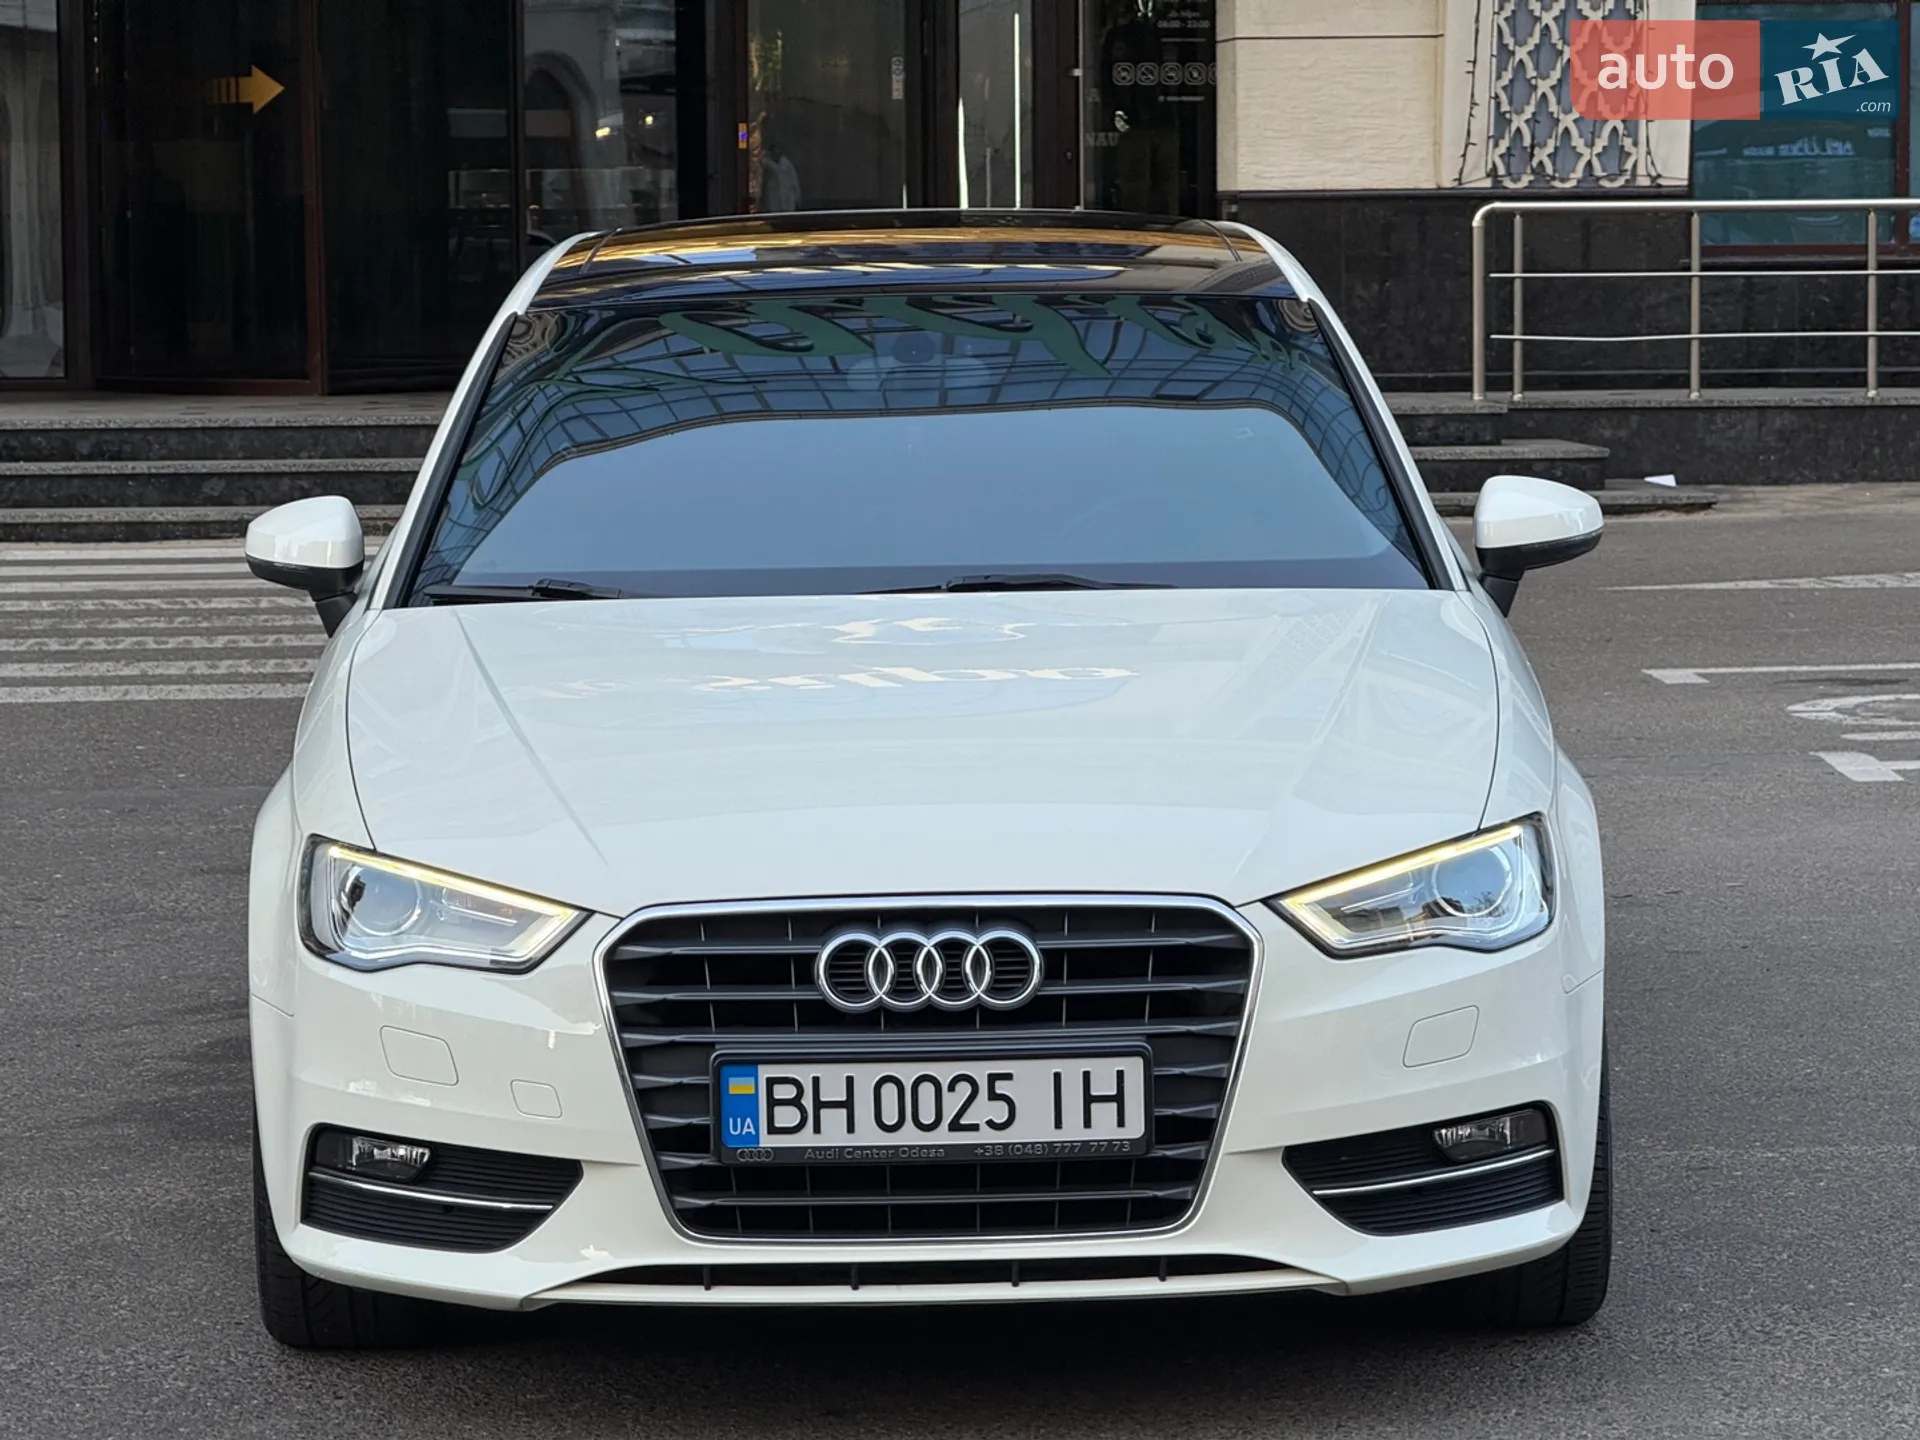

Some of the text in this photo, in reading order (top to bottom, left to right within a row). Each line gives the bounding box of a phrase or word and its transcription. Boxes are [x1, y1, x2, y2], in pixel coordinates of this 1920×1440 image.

[765, 1069, 1126, 1135] BH 0025 IH
[729, 1118, 755, 1135] UA
[804, 1147, 945, 1160] Audi Center Odesa
[974, 1141, 1131, 1156] +38 (048) 777 77 73
